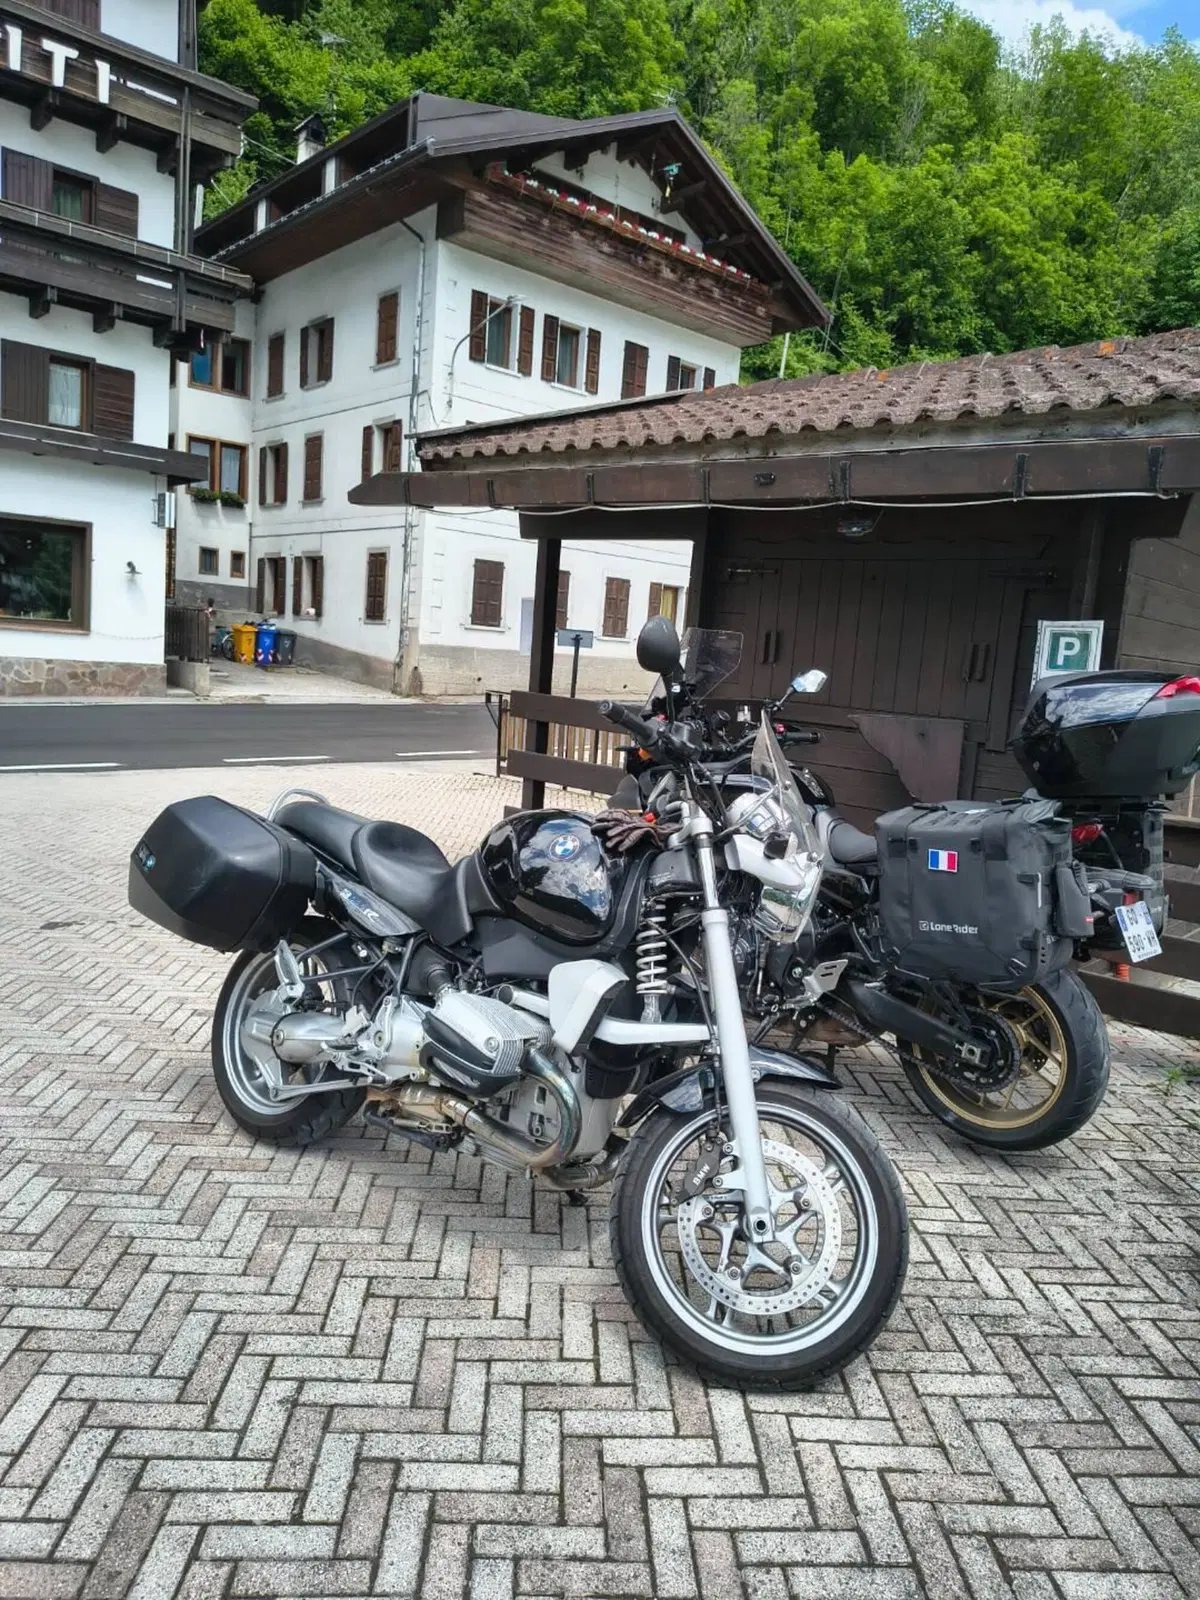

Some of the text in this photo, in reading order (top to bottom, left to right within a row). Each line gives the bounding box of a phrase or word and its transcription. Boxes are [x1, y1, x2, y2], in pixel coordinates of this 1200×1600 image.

[0, 24, 110, 104] ITI
[1057, 636, 1081, 666] P
[692, 1163, 710, 1186] BMW
